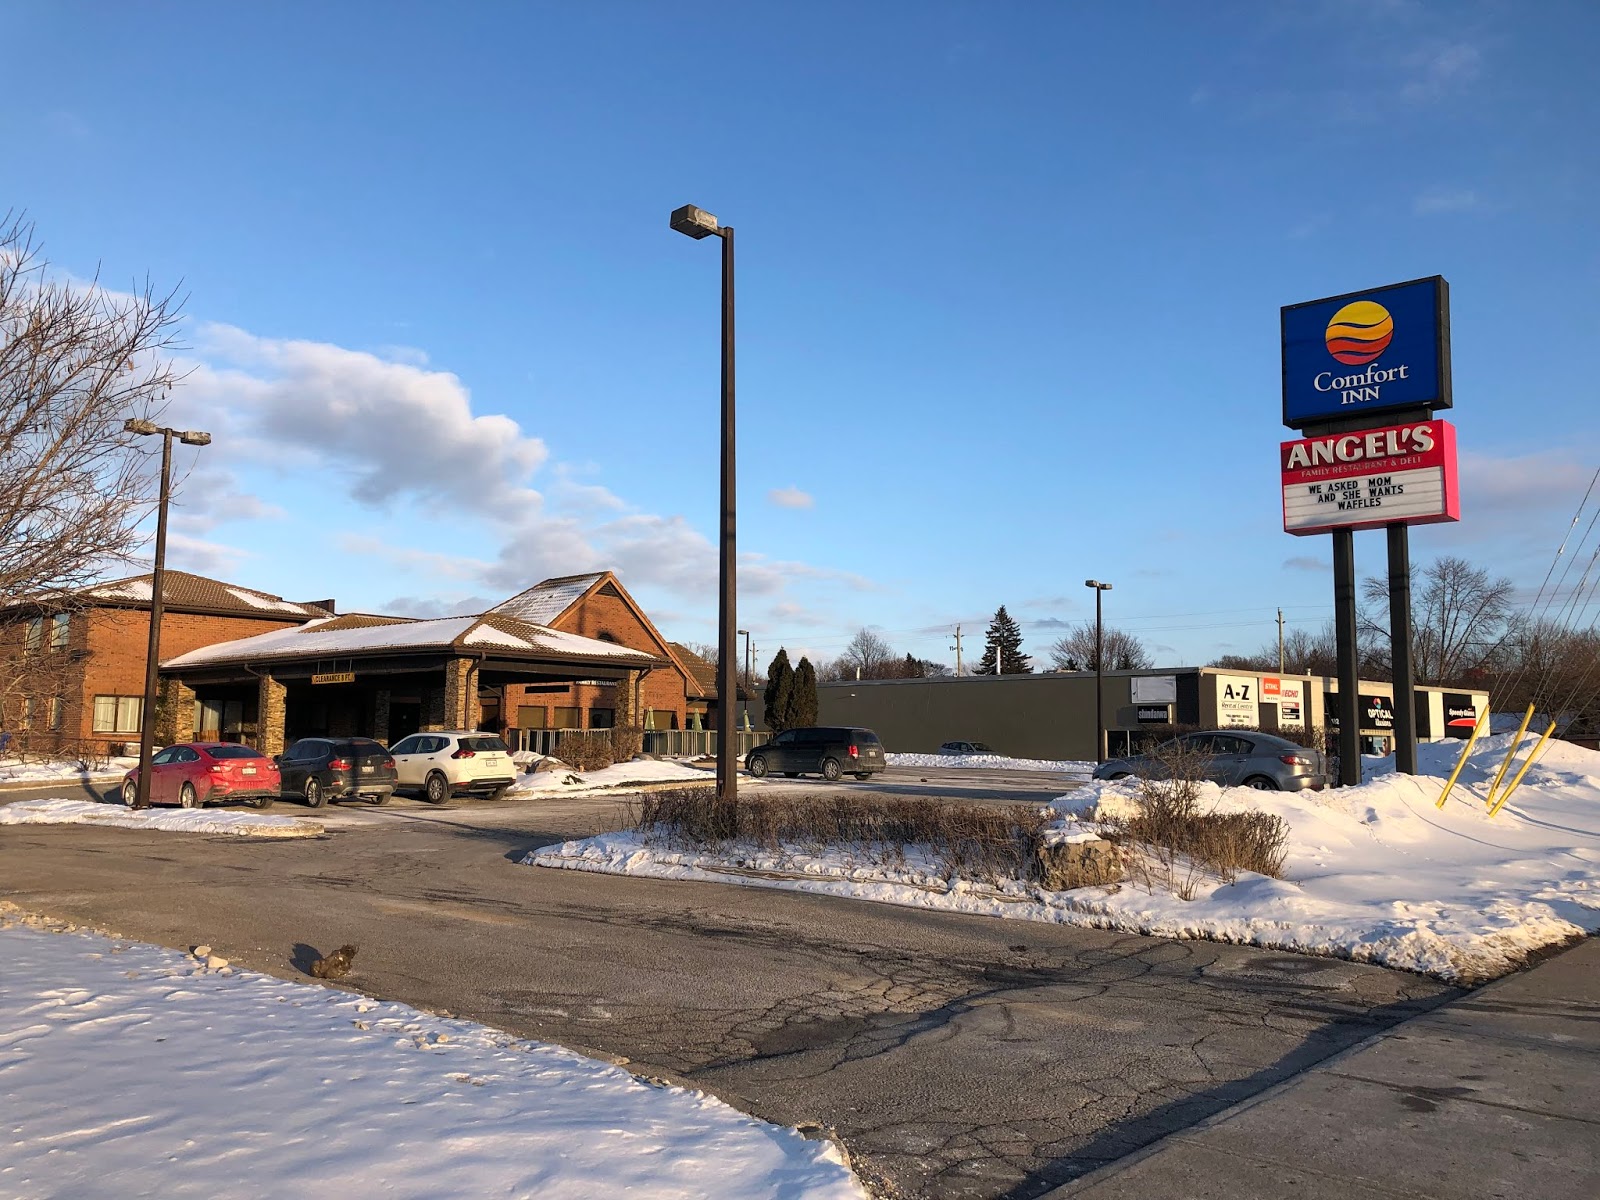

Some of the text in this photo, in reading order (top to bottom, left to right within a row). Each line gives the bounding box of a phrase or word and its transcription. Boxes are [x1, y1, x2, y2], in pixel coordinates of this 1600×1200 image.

[1314, 363, 1409, 392] Comfort
[1341, 386, 1380, 404] INN
[1287, 425, 1435, 469] ANGEL'S
[1301, 456, 1421, 478] FAMILY RESTAURANT & DELI
[1309, 476, 1392, 494] WE ASKED MOM
[1318, 485, 1404, 504] AND SHE WANTS
[1338, 497, 1382, 510] WAFFLES
[316, 675, 340, 683] CLEARANCE
[1224, 684, 1250, 700] A-Z
[1284, 689, 1299, 698] ECHO
[1367, 708, 1394, 720] OPTICAL
